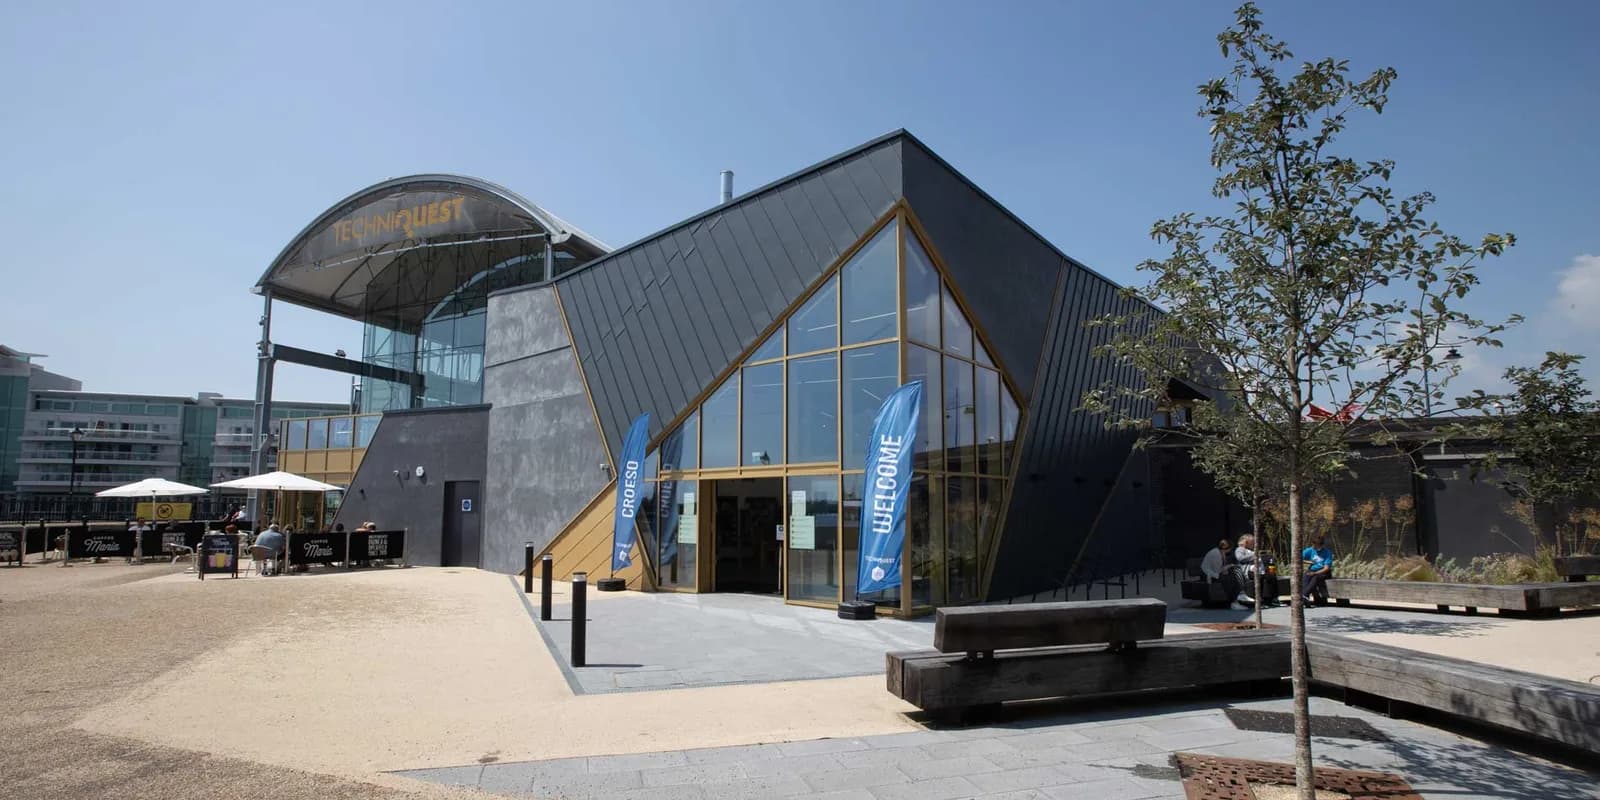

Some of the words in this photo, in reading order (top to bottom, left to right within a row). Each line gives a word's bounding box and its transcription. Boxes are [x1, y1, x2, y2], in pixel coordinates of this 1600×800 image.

[333, 196, 465, 247] TECHNIQUEST
[621, 460, 639, 518] CROESO
[872, 434, 902, 534] WELCOME
[84, 539, 120, 552] Mania
